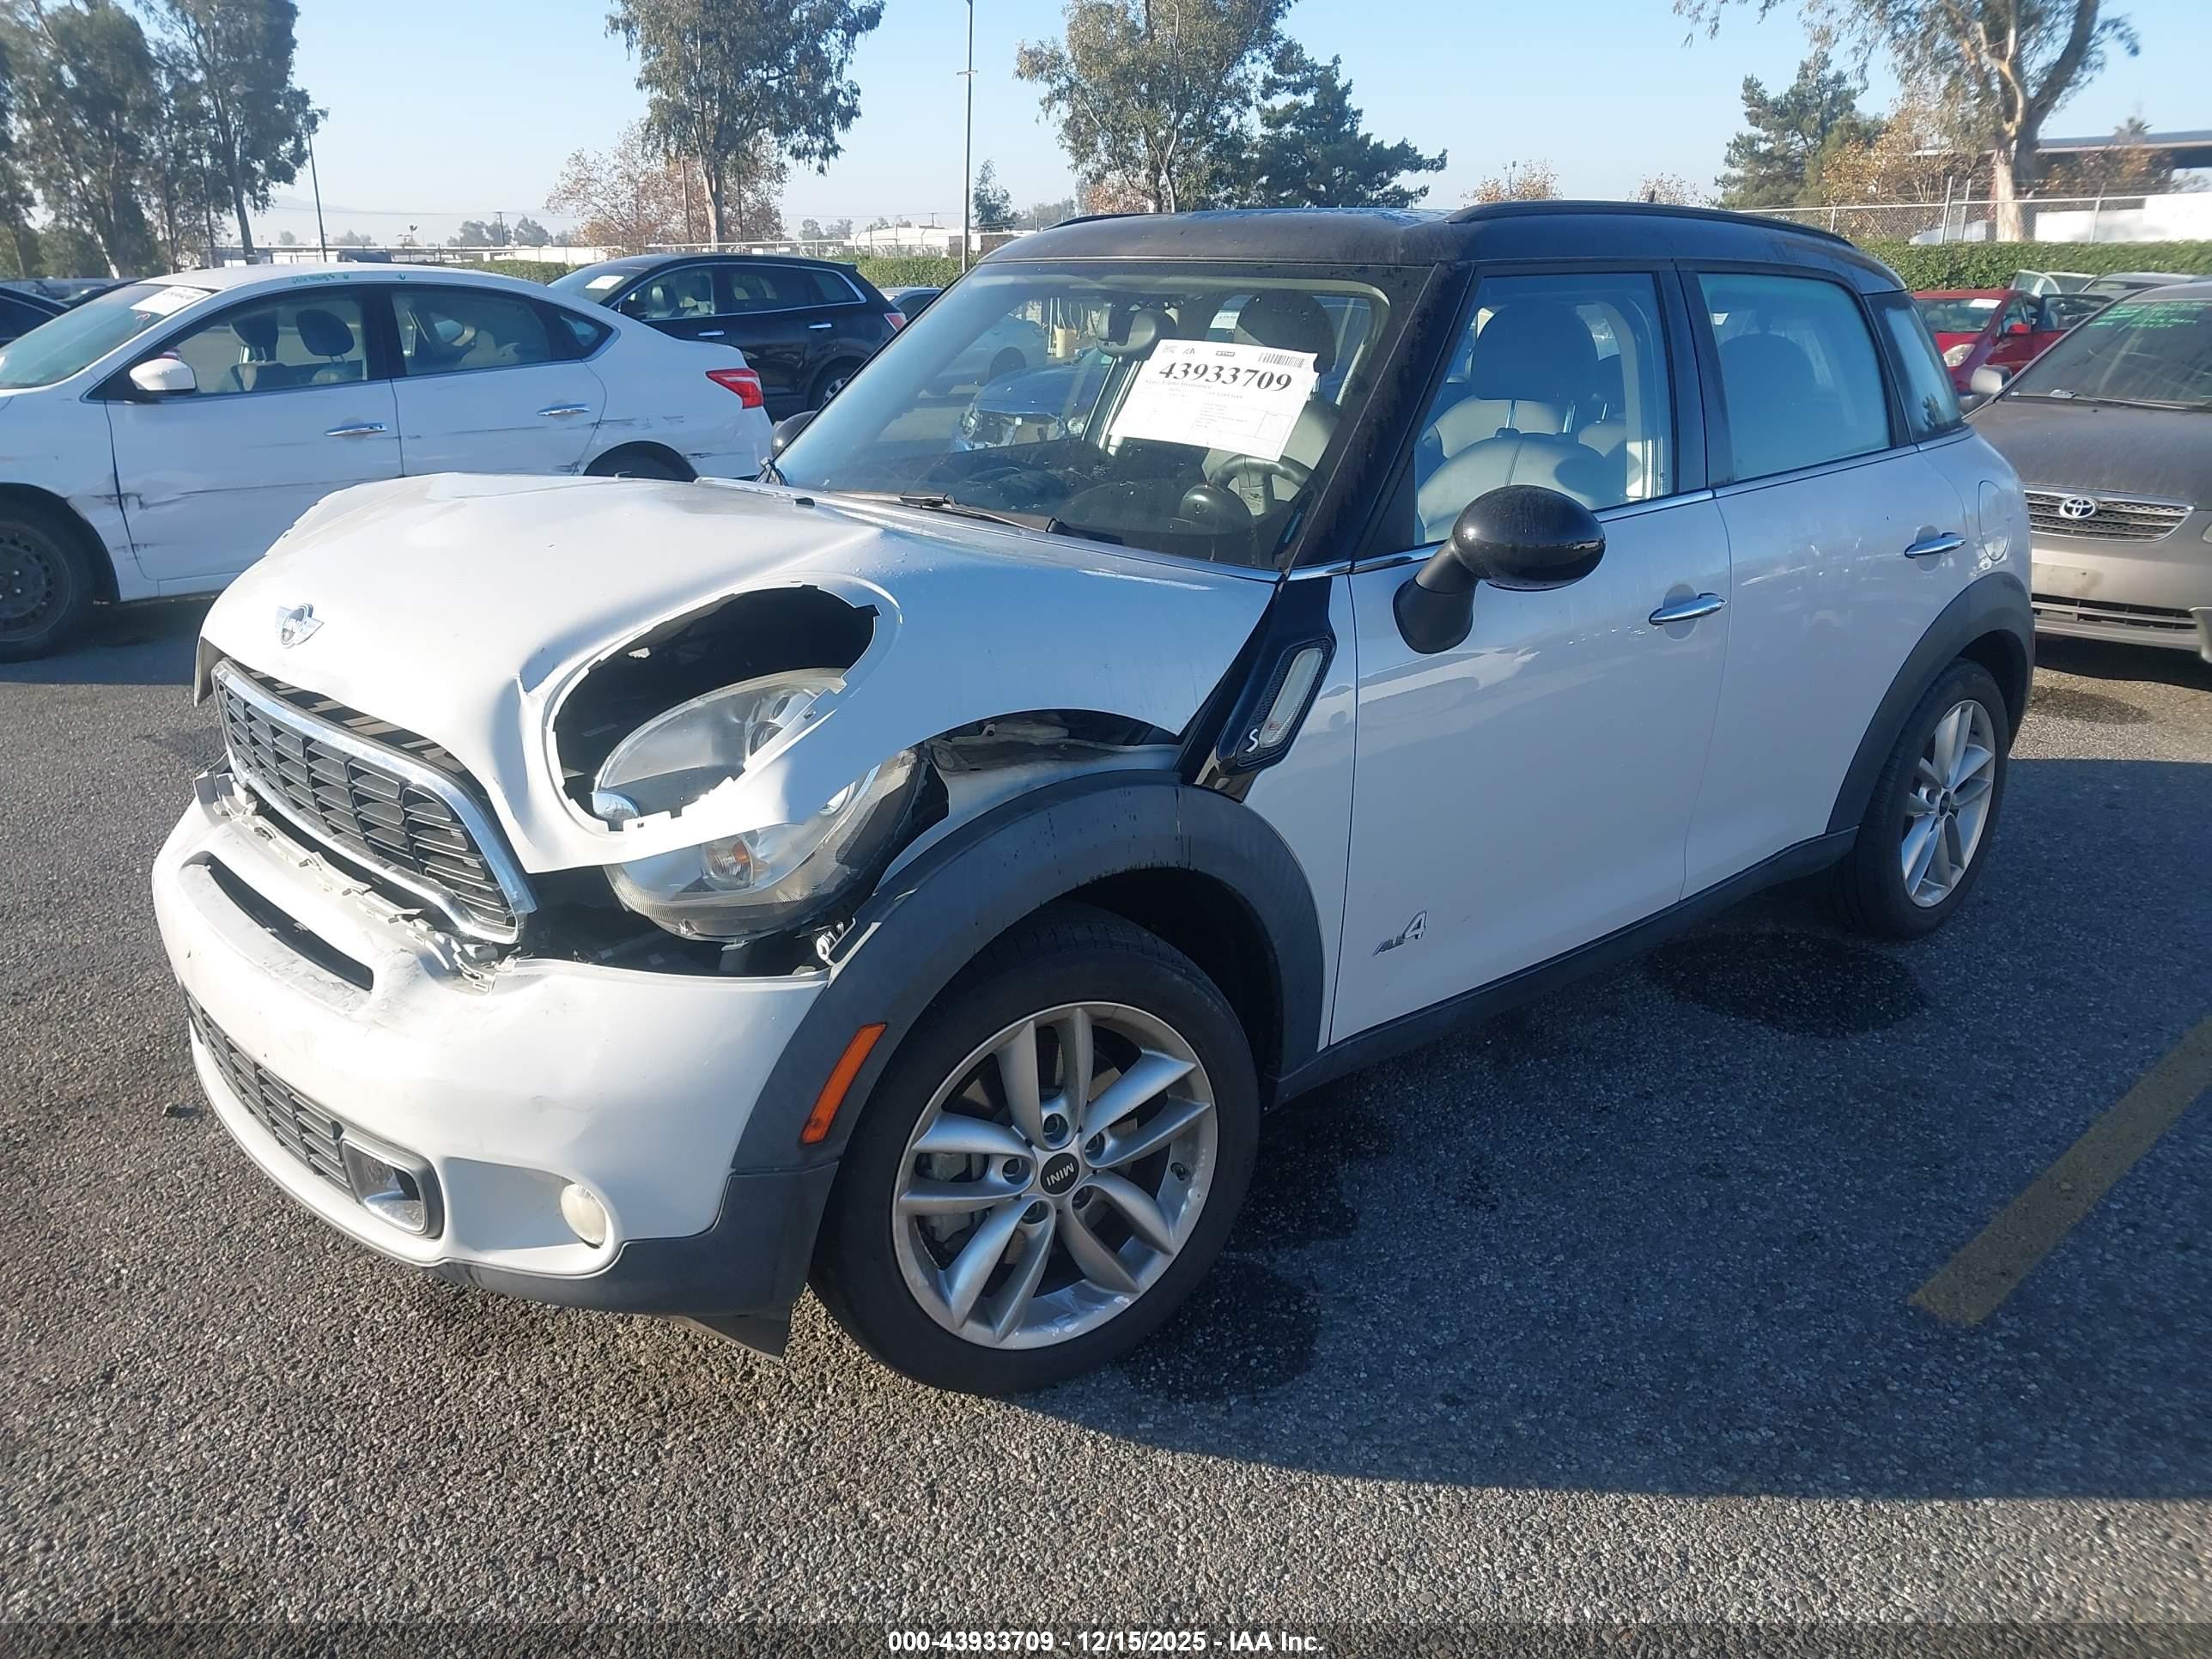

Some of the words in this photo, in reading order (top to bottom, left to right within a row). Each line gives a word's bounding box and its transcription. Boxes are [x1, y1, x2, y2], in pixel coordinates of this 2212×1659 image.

[1158, 362, 1292, 392] 43933709
[1245, 728, 1259, 753] S
[1046, 1162, 1075, 1187] MINI
